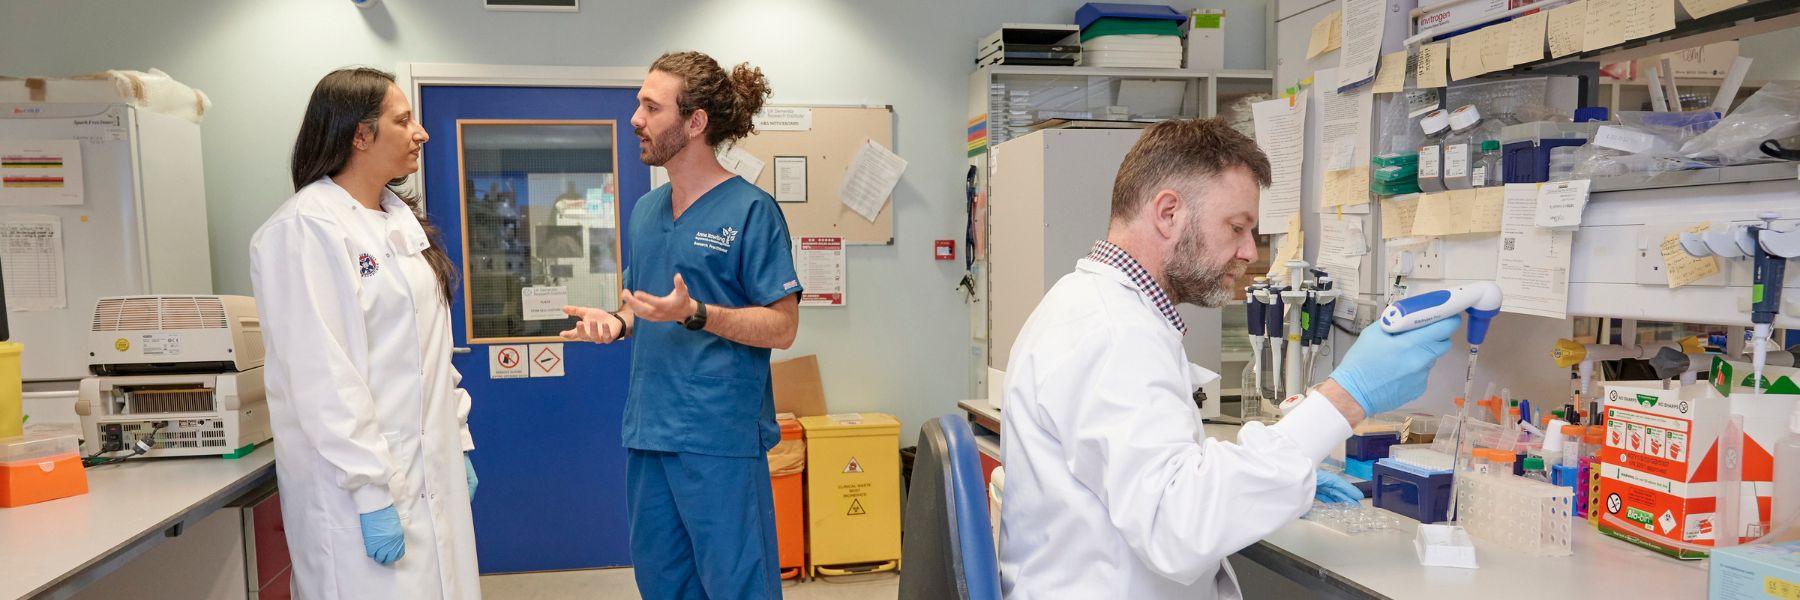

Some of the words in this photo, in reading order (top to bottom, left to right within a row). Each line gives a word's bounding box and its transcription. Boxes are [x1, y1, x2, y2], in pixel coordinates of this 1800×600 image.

[1421, 11, 1451, 26] invitrogen
[708, 233, 726, 243] Rowling
[1627, 509, 1651, 524] Bio-bin
